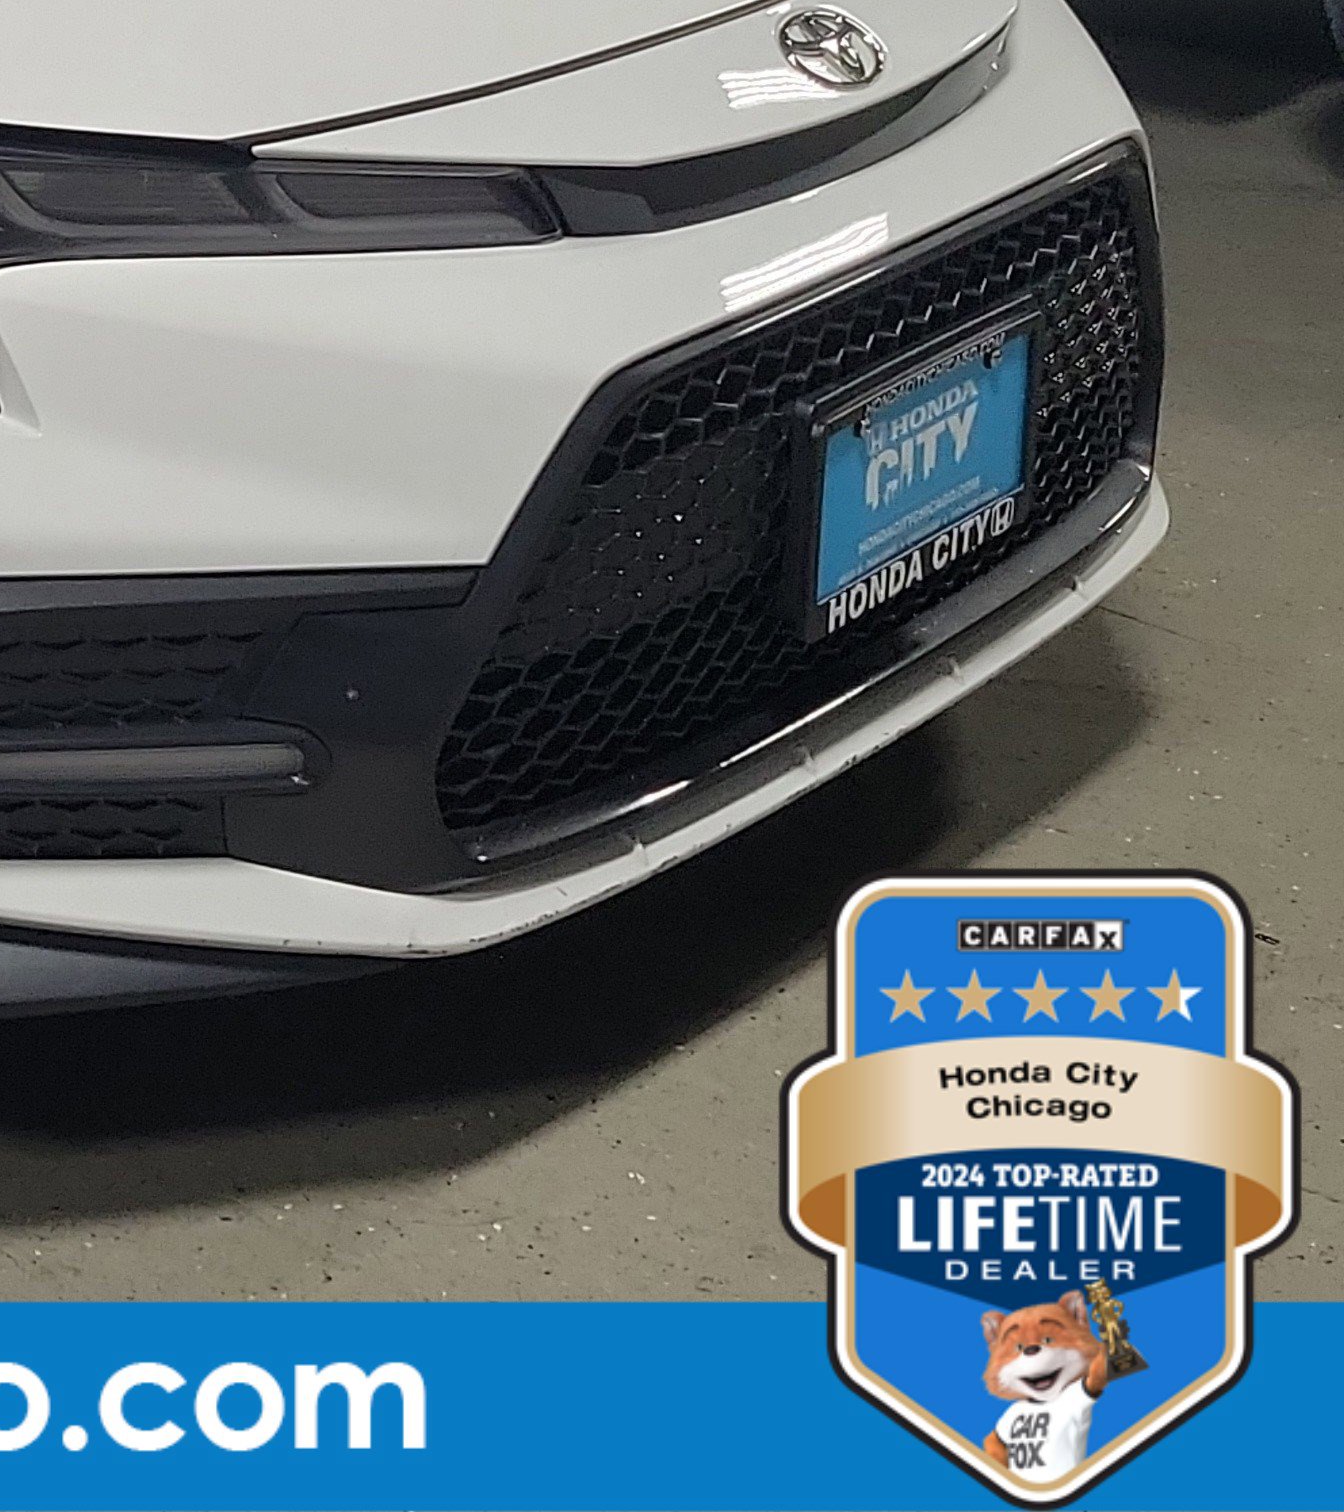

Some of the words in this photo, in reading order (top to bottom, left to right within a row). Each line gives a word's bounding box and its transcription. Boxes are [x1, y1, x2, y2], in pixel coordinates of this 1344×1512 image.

[866, 400, 979, 511] CITY
[889, 379, 979, 440] HONDA
[827, 550, 923, 634] HONDA
[932, 508, 991, 571] CITY
